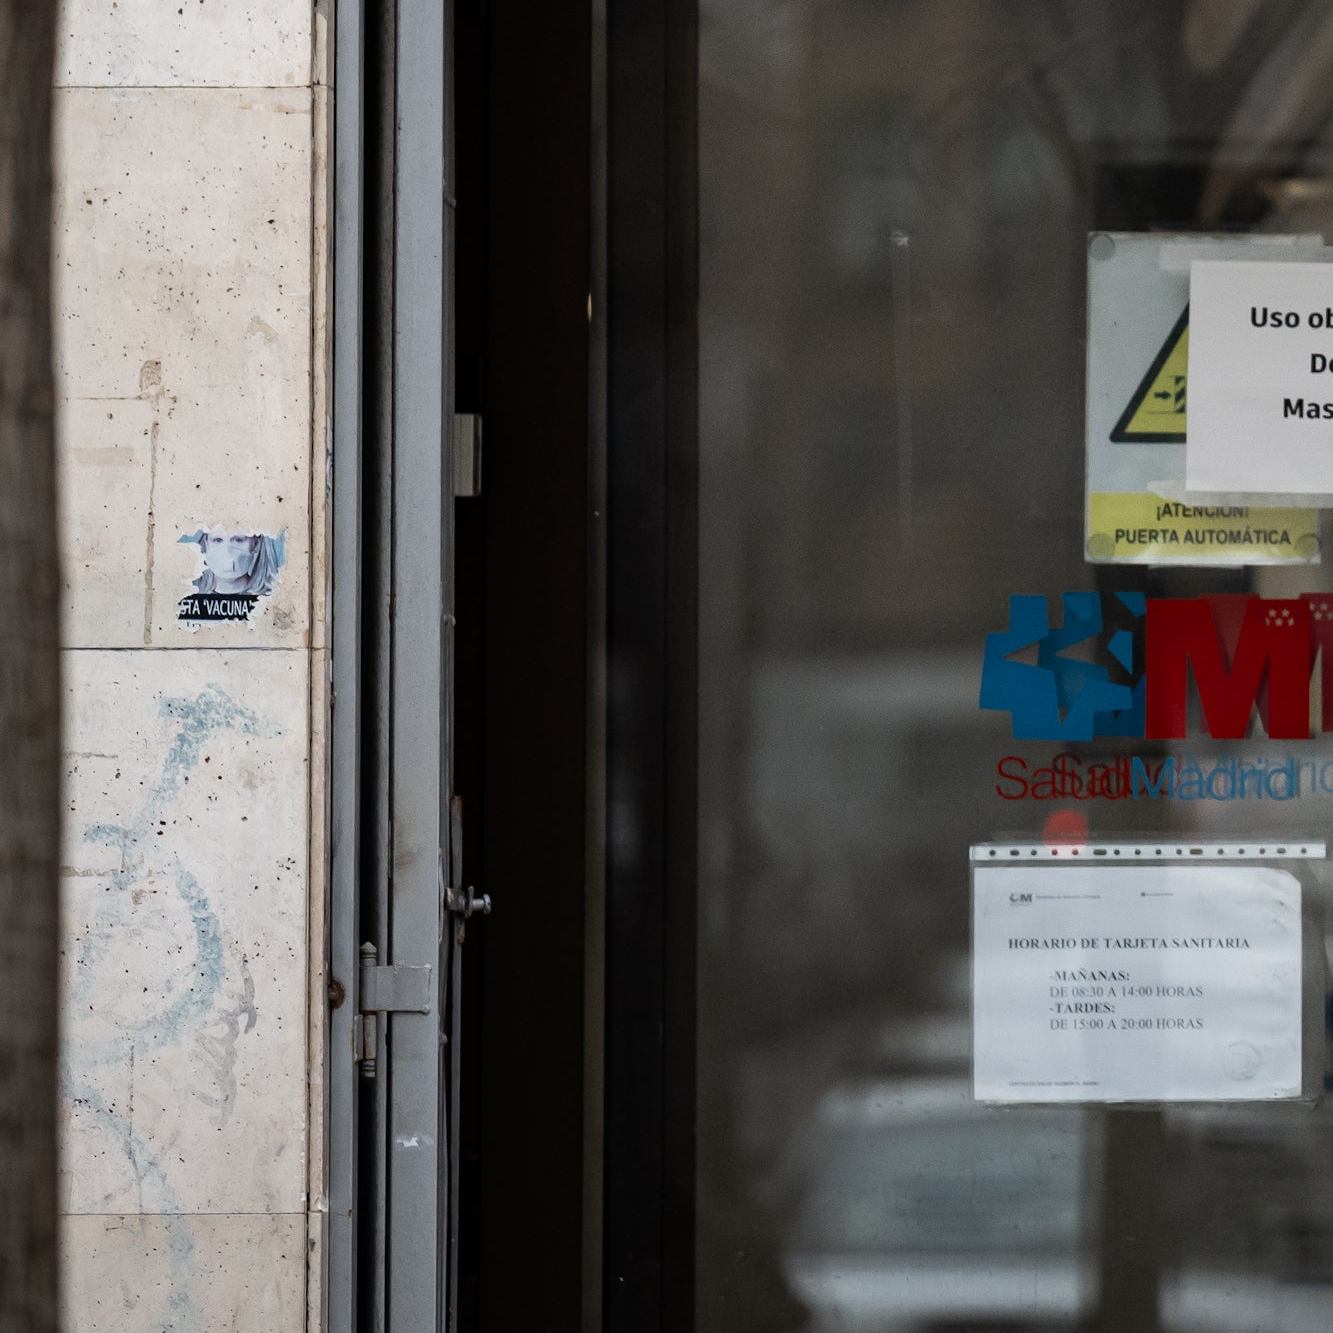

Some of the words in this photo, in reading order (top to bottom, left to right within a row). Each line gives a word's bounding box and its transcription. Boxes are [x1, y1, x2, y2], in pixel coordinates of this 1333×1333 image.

[1250, 307, 1300, 329] Uso
[1115, 528, 1180, 544] PUERTA
[1184, 527, 1291, 544] AUTOMÁTICA
[1008, 938, 1077, 950] HORARIO
[1081, 938, 1099, 949] DE
[1105, 938, 1168, 950] TARJETA
[1171, 938, 1250, 950] SANITARIA
[1050, 987, 1068, 997] DE
[1072, 986, 1104, 997] 08:30
[1107, 987, 1117, 997] A
[1122, 986, 1153, 997] 14:00
[1156, 986, 1203, 997] HORAS
[1050, 1019, 1068, 1029] DE
[1073, 1018, 1104, 1030] 15:00
[1107, 1019, 1117, 1029] A
[1121, 1018, 1153, 1029] 20:00
[1156, 1018, 1203, 1029] HORAS
